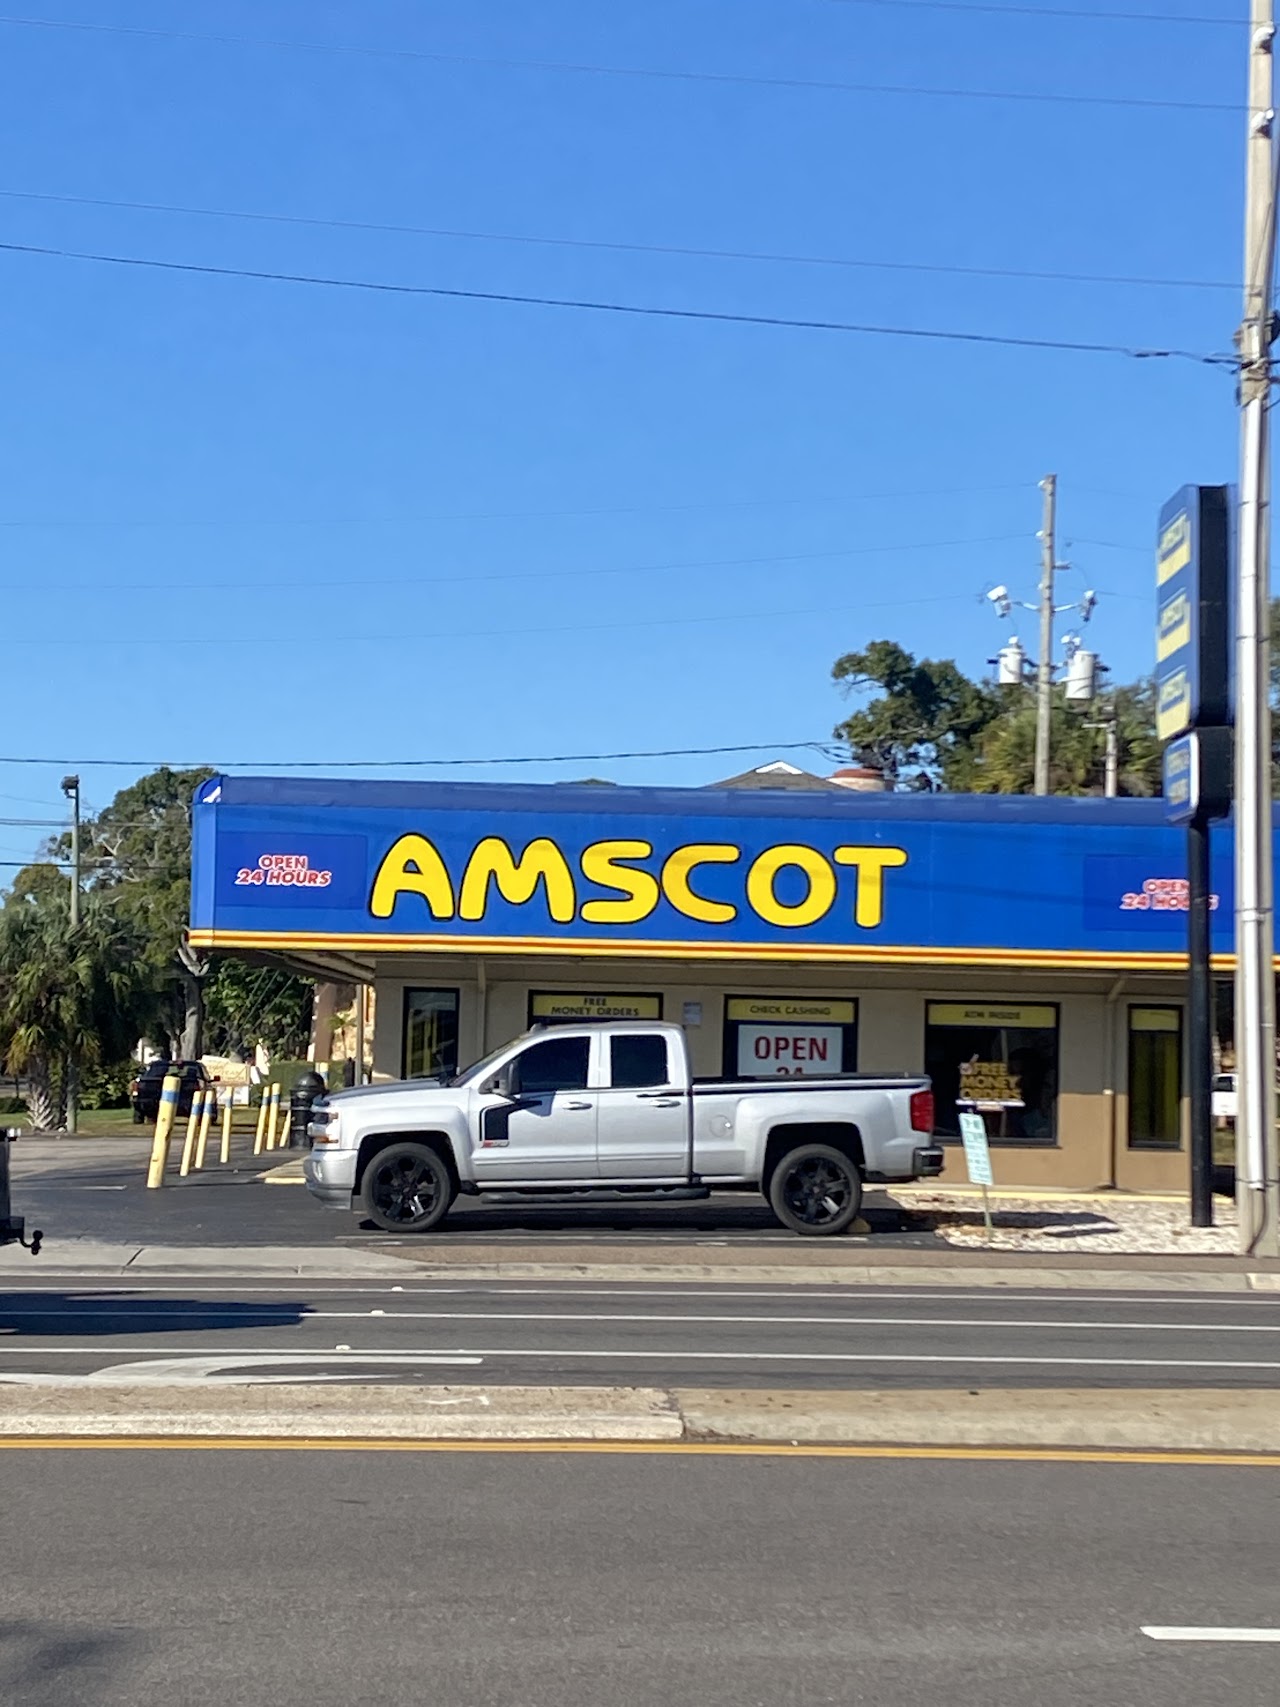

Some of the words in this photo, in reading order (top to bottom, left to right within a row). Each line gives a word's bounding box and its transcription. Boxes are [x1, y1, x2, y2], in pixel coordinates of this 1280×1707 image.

[259, 854, 308, 870] OPEN
[235, 868, 264, 885] 24
[266, 869, 332, 887] HOURS
[369, 833, 908, 929] AMSCOT
[1120, 893, 1150, 910] 24
[583, 997, 607, 1006] FREE
[551, 1006, 591, 1016] MONEY
[597, 1006, 639, 1017] ORDERS
[750, 1005, 782, 1014] CHECK
[785, 1006, 831, 1016] CASHING
[754, 1036, 827, 1061] OPEN
[974, 1062, 1007, 1075] FREE
[960, 1075, 1022, 1089] MONEY
